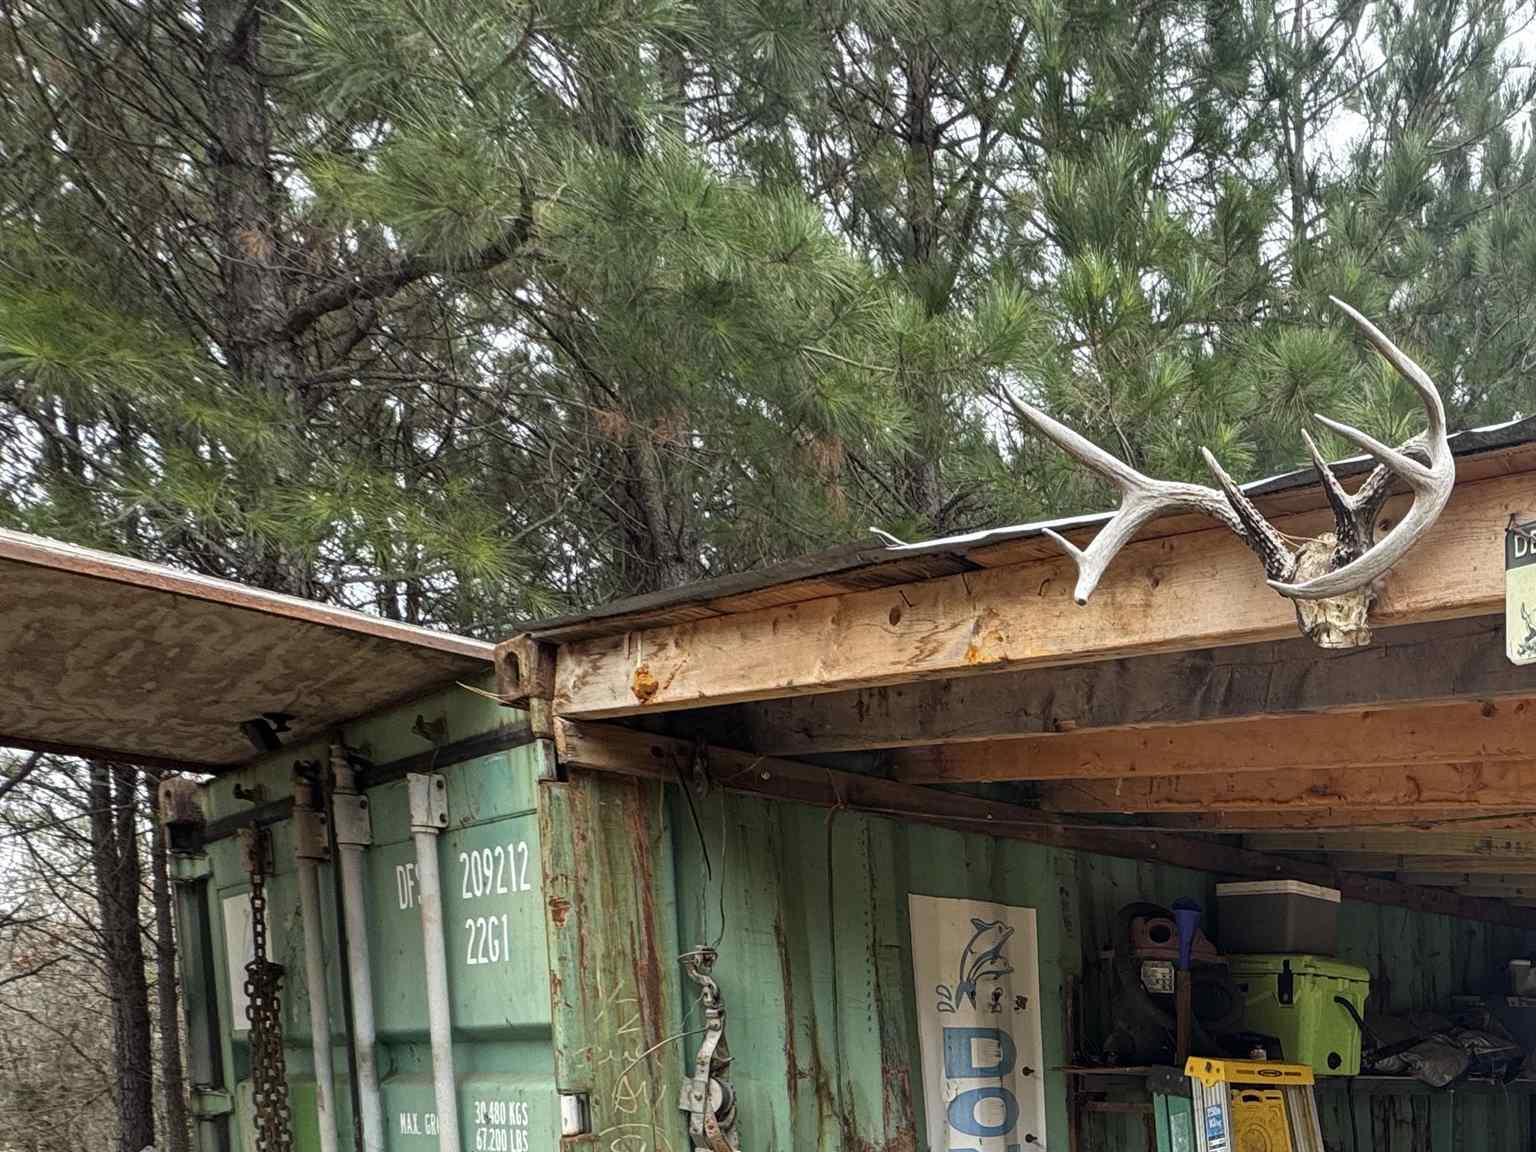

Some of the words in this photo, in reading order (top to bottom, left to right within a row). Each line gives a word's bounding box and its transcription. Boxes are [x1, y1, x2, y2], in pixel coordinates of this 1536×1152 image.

[396, 863, 421, 910] DF
[459, 841, 531, 899] 209212
[465, 914, 510, 965] 22G1
[509, 1102, 528, 1126] KGS
[510, 1128, 528, 1152] LBS
